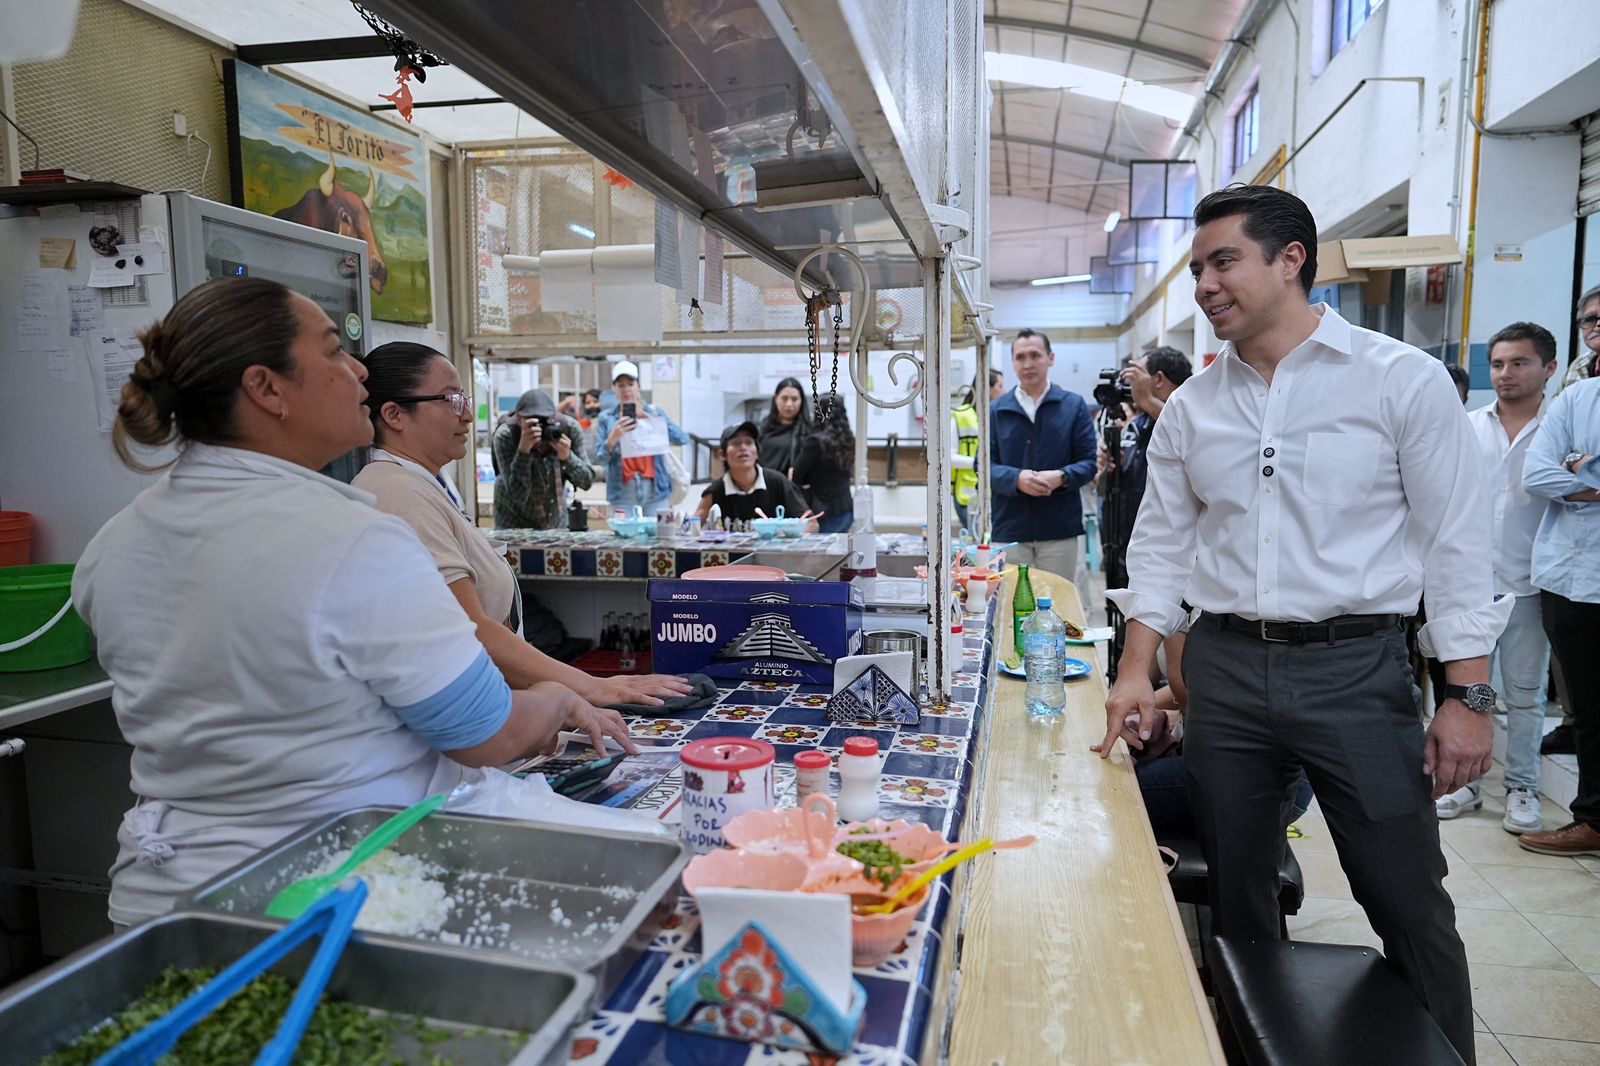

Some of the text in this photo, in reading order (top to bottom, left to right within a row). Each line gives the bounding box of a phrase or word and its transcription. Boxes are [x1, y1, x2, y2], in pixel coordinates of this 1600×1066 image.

[657, 622, 717, 643] JUMBO
[741, 667, 804, 677] AZTECA
[694, 813, 722, 830] POR
